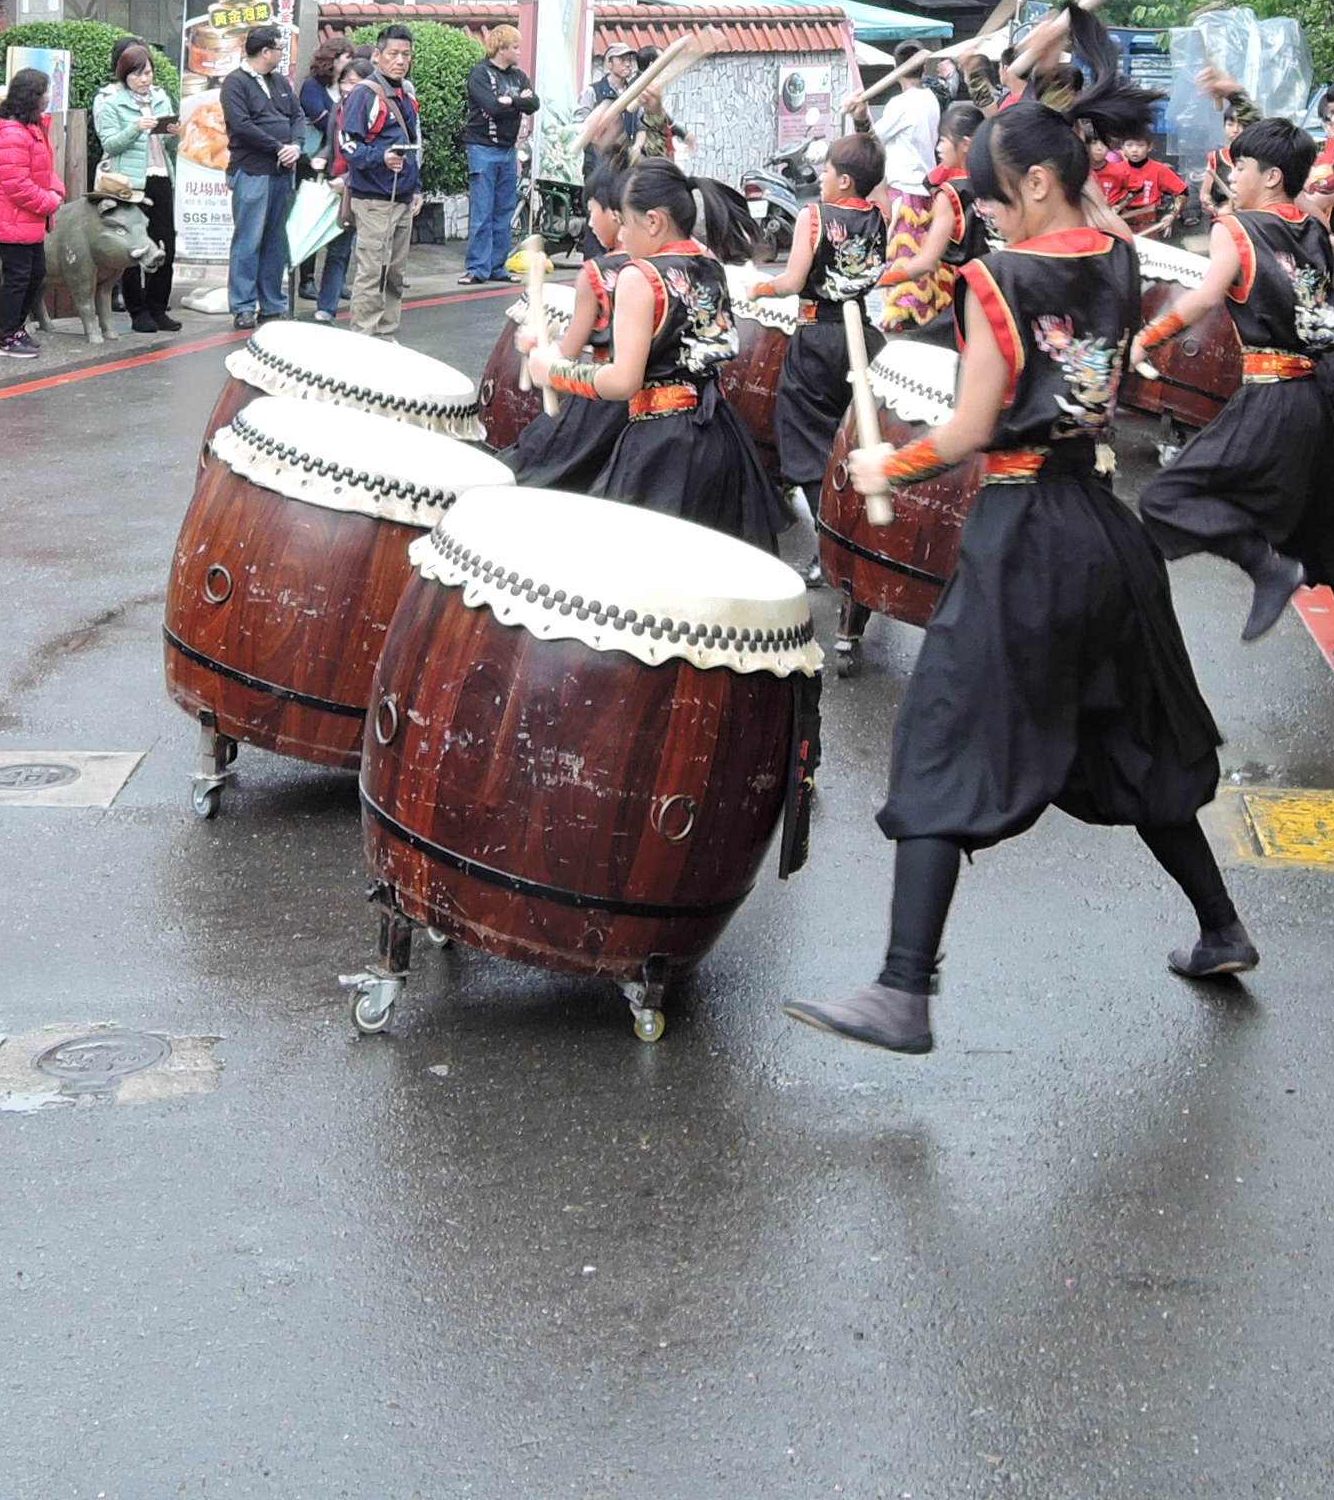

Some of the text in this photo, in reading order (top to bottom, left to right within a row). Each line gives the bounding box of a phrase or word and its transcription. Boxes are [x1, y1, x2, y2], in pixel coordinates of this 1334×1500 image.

[214, 4, 270, 27] 黃金泡菜
[182, 212, 208, 224] SGS
